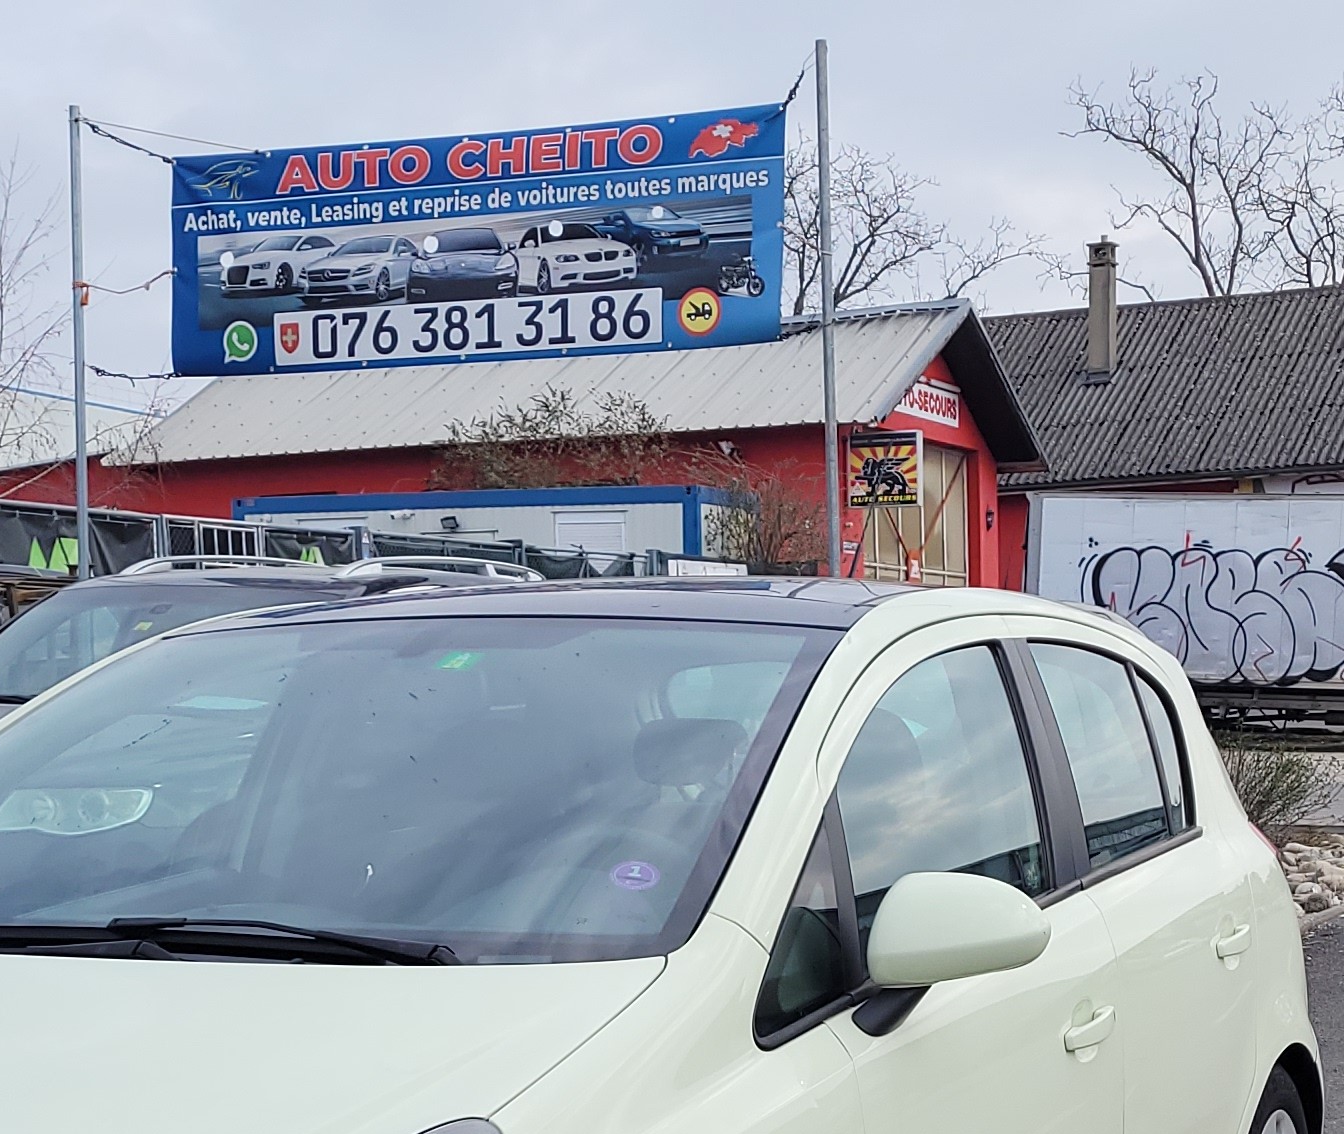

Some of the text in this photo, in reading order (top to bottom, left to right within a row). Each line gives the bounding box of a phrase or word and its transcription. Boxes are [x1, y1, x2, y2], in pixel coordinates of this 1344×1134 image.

[275, 124, 663, 194] AUTO CHEITO
[183, 168, 769, 232] Achat, vente, Leasing et reprise de voitures toutes marques
[312, 293, 651, 360] 076 381 31 86
[878, 494, 917, 502] SECOURS
